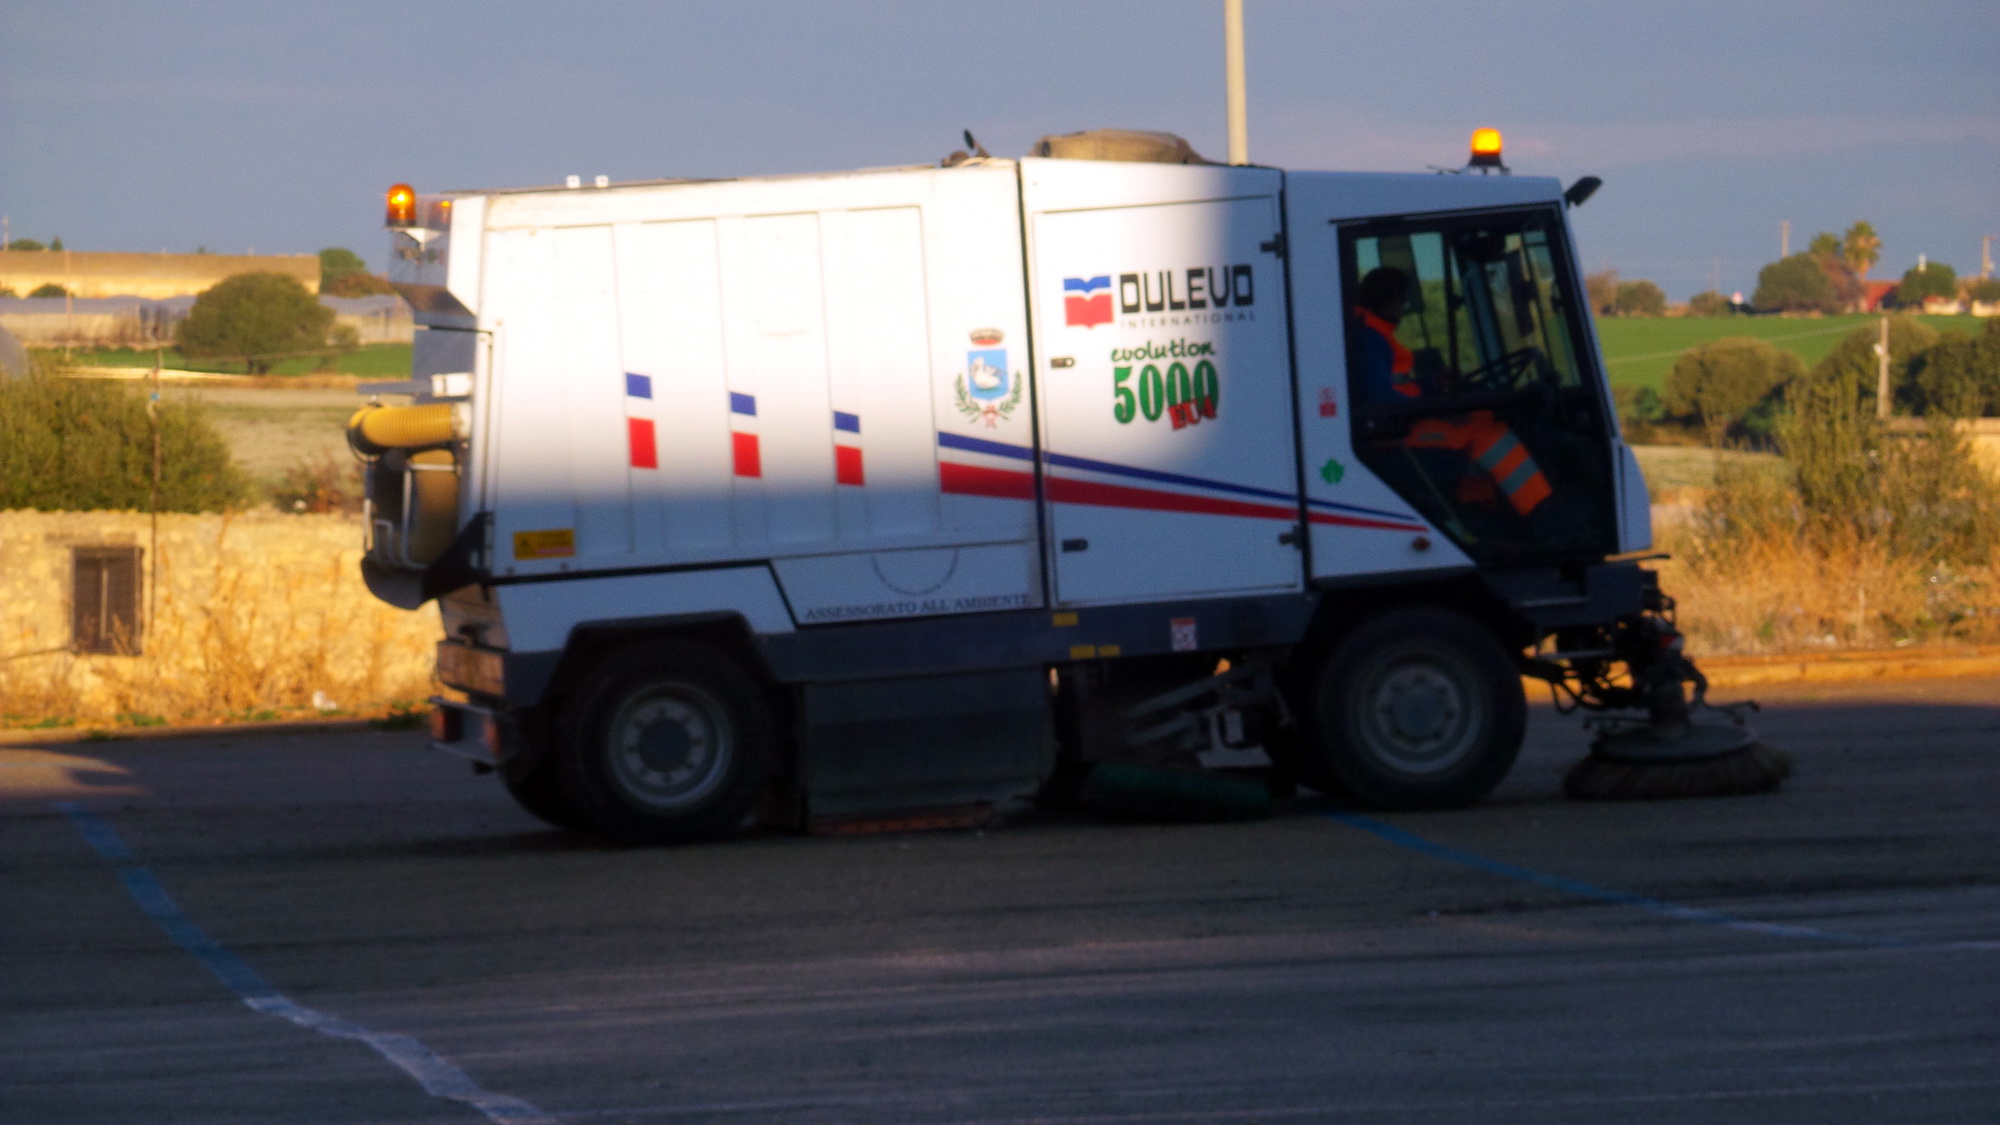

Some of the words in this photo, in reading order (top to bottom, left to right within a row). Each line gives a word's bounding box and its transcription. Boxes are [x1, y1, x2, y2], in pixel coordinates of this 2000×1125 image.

[1120, 264, 1253, 314] DULEVO
[1121, 312, 1255, 329] INTERNATIONAL
[1111, 338, 1216, 362] evolution
[1114, 359, 1219, 424] 5000
